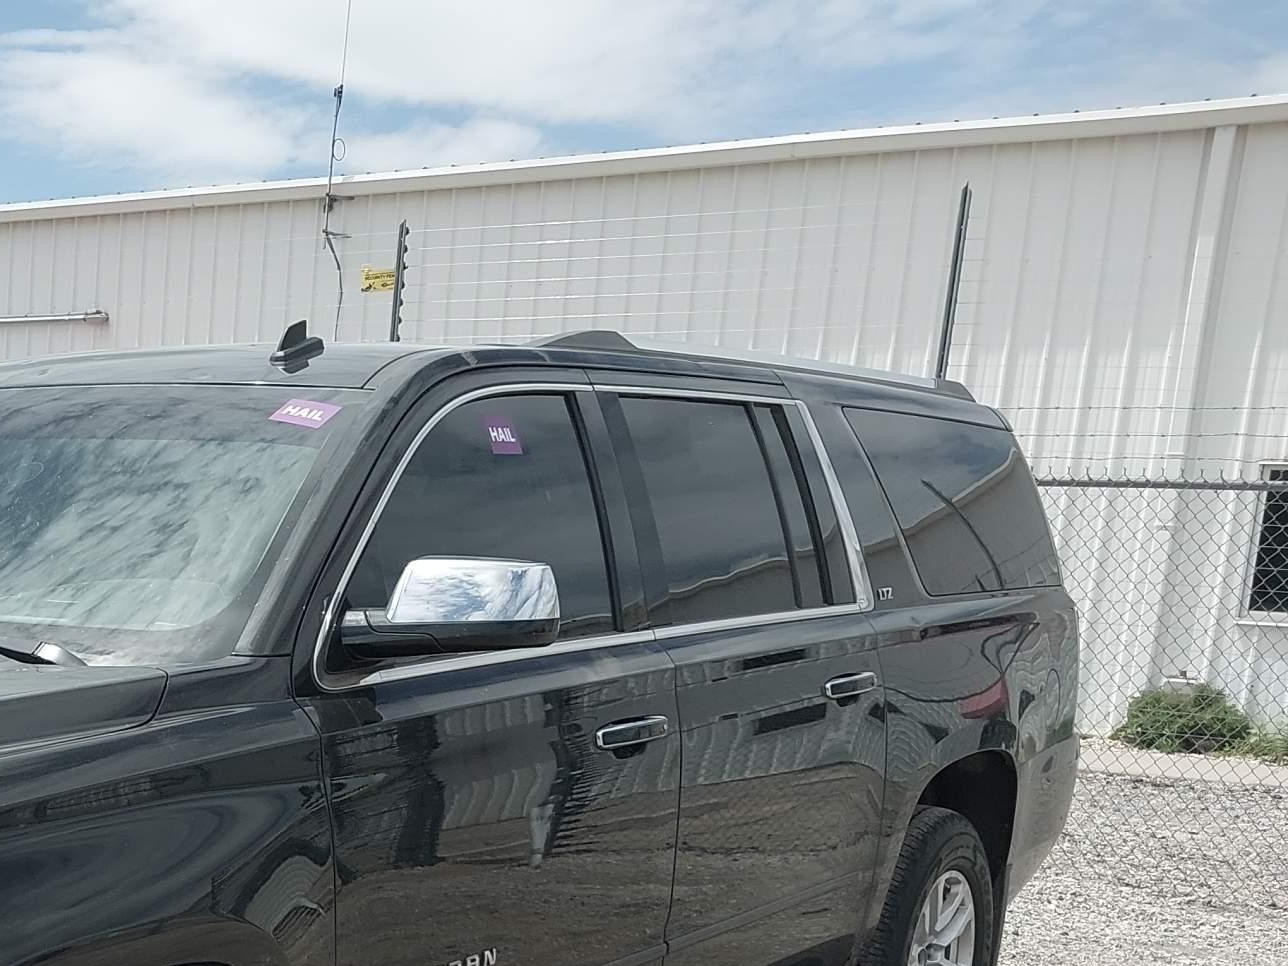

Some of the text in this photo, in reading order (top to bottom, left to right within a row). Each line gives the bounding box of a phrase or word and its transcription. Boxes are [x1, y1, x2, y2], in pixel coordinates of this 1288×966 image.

[280, 405, 324, 421] HAIL
[488, 427, 516, 442] HAIL
[877, 587, 893, 601] LTZ
